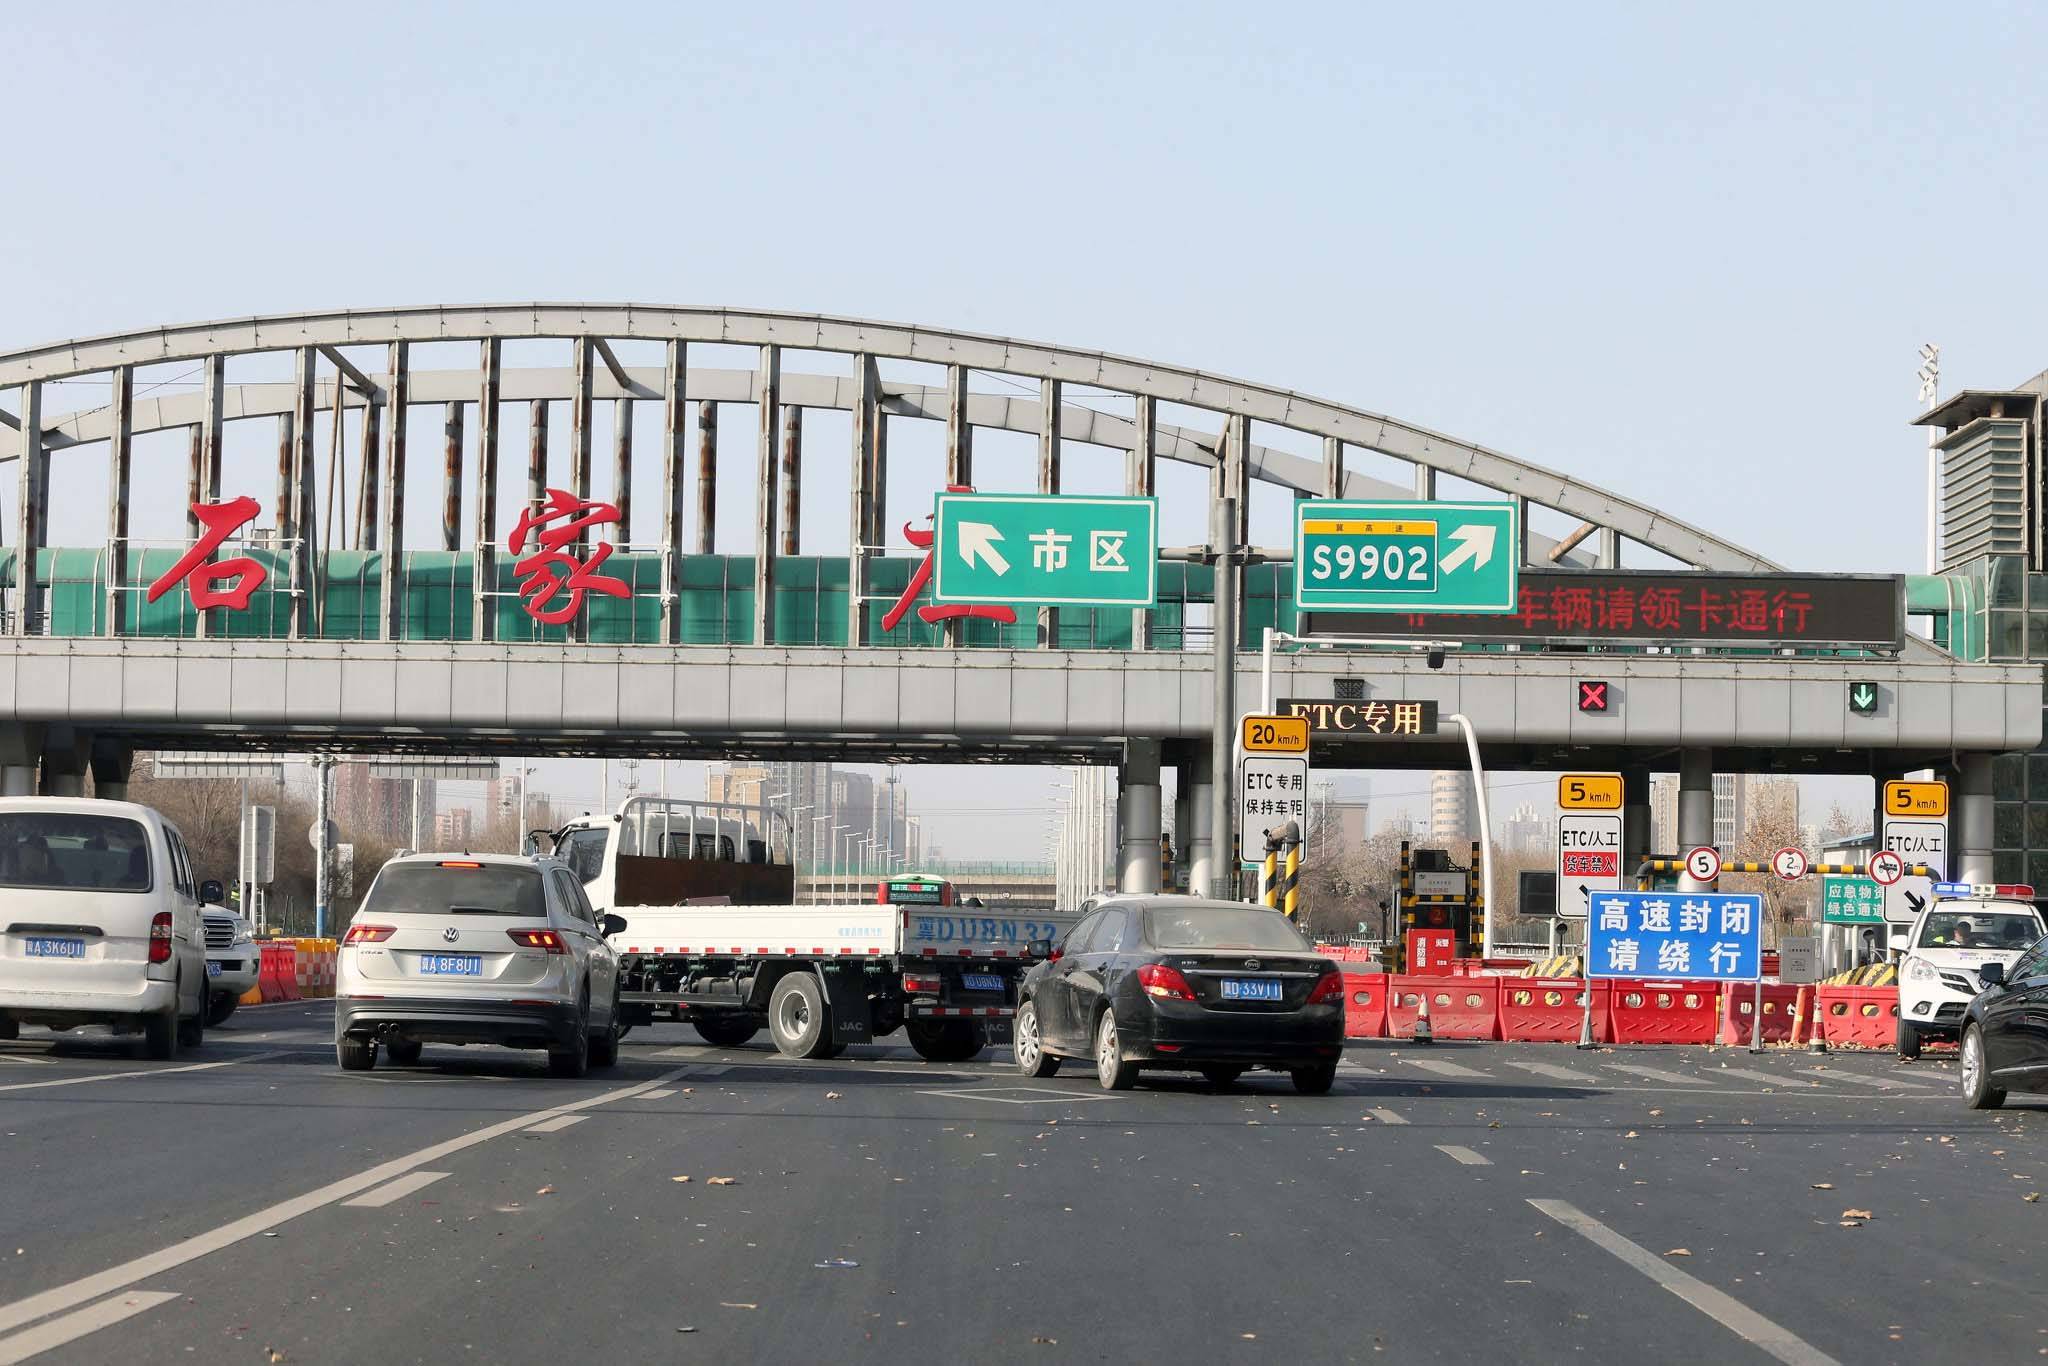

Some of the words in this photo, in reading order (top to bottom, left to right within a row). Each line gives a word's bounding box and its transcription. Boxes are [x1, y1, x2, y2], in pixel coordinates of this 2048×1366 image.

[1029, 529, 1129, 573] 市区
[1312, 545, 1428, 580] S9902
[1252, 725, 1275, 744] 20
[1277, 735, 1300, 745] km/h
[1570, 783, 1586, 801] 5
[1589, 793, 1611, 803] km/h
[1896, 789, 1912, 808] 5
[1916, 799, 1938, 809] km/h
[1246, 800, 1303, 816] 保持车距
[1565, 856, 1616, 873] 货车禁入
[1697, 855, 1709, 873] 5
[1599, 899, 1751, 935] 高速封闭
[1607, 938, 1742, 974] 请绕行
[839, 1021, 863, 1031] JAC
[980, 1023, 1005, 1032] JAC
